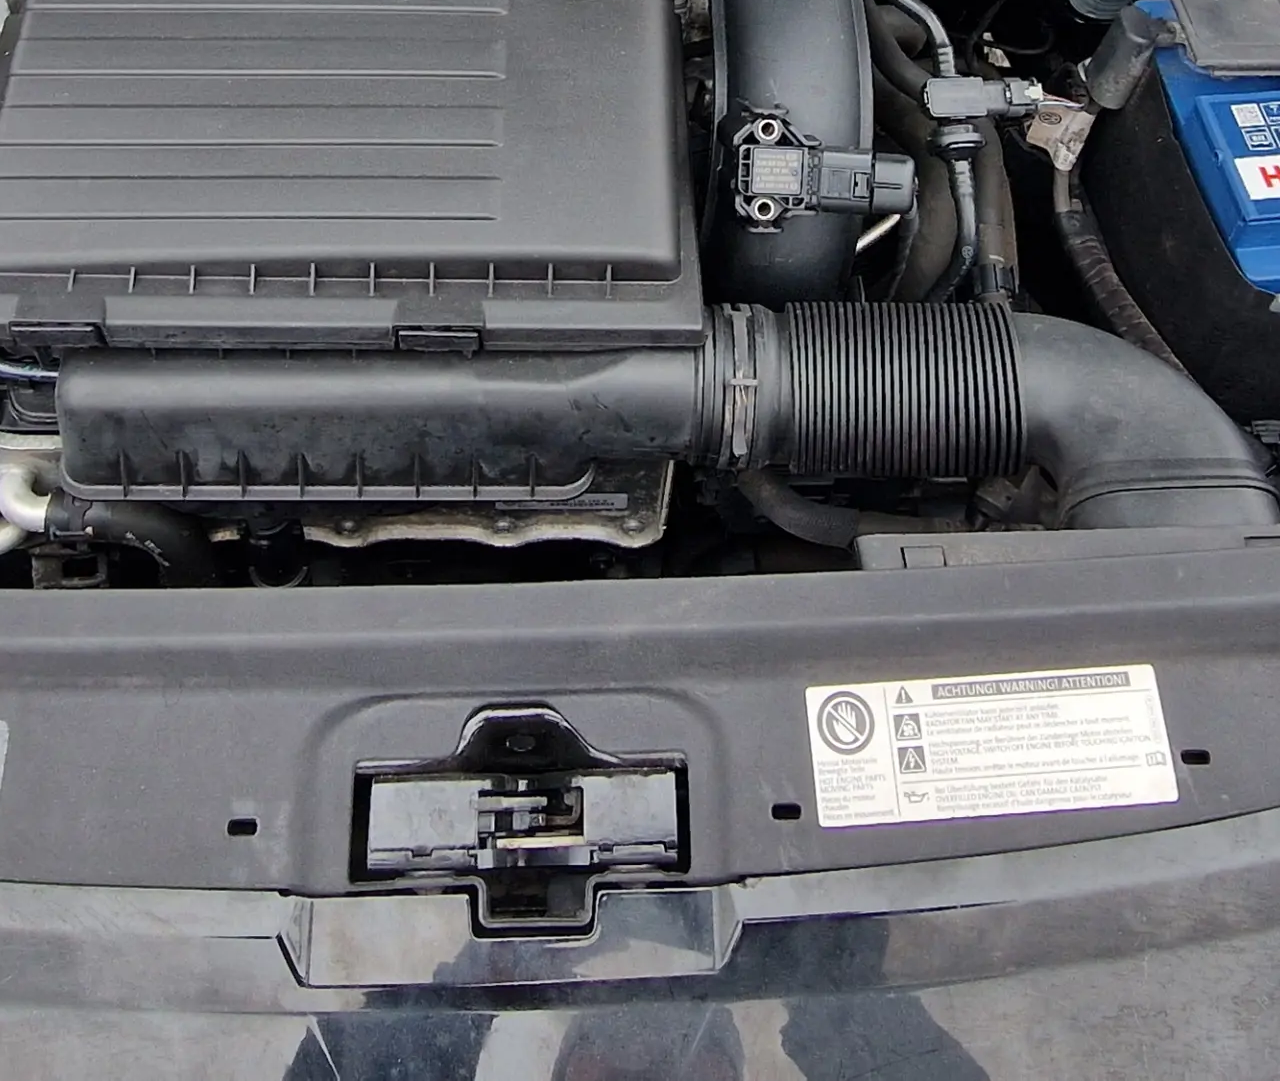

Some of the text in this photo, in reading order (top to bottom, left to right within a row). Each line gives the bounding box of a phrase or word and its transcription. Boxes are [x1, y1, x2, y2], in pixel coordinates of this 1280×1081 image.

[936, 676, 1126, 696] ACHTUNG! WARNING! ATTENTION!
